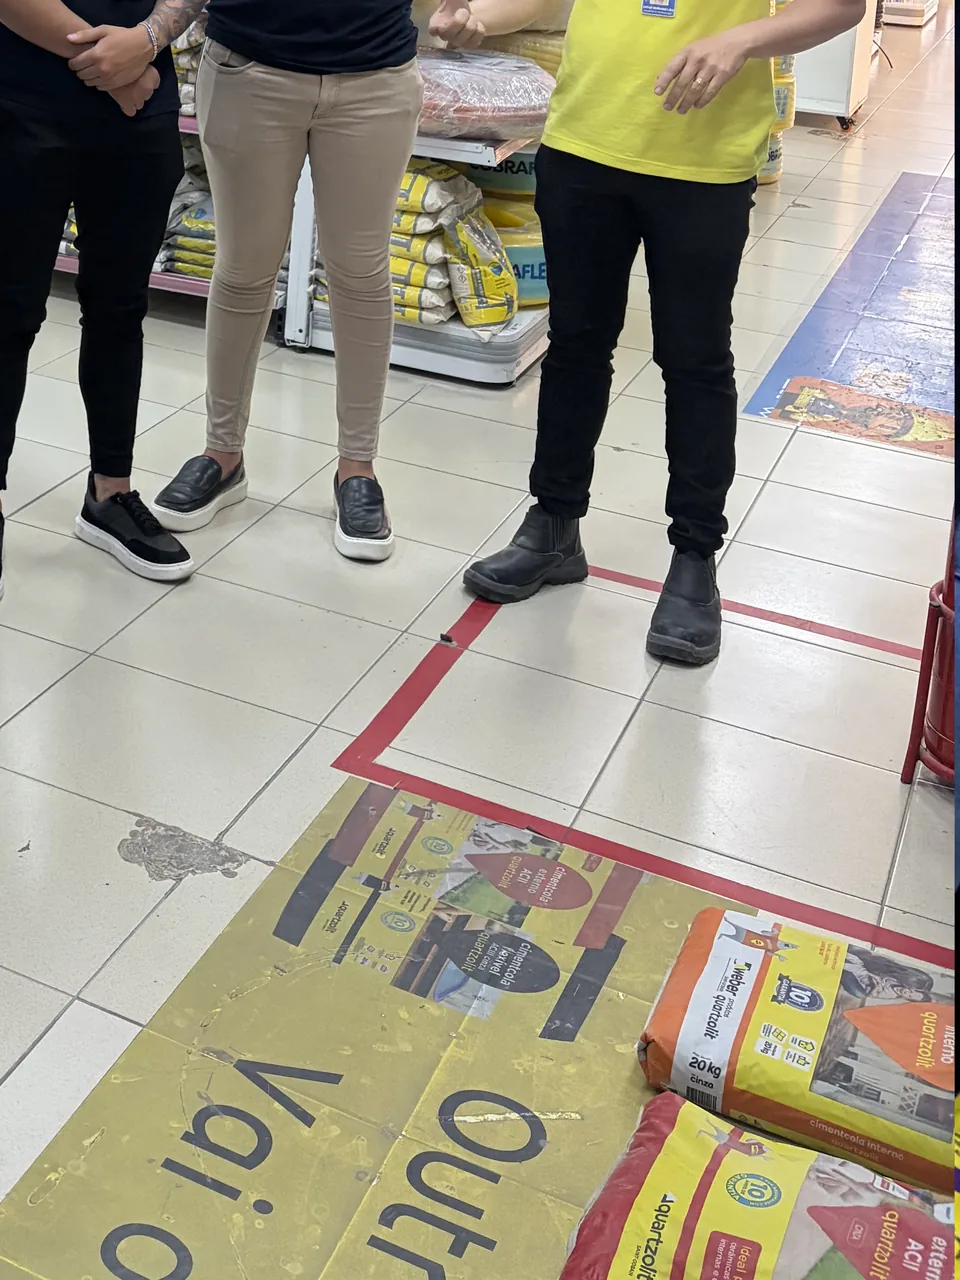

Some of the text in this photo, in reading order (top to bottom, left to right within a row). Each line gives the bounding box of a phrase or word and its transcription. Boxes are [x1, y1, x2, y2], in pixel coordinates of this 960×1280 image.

[497, 855, 523, 889] quartzolit
[528, 868, 548, 894] externo
[539, 866, 566, 902] cimentcola
[461, 932, 490, 972] quartzolit
[500, 942, 532, 986] cimentcola
[725, 967, 746, 996] weber
[789, 987, 812, 1001] 10
[704, 994, 726, 1040] quartzolit
[915, 1011, 938, 1069] quartzolit
[690, 1075, 714, 1089] cinza
[160, 1058, 344, 1215] Vai
[810, 1119, 905, 1162] cimentcola interno
[747, 1183, 768, 1199] 10
[636, 1204, 672, 1280] quartzolit
[714, 1239, 727, 1268] internas
[733, 1245, 753, 1273] Ideal
[868, 1210, 900, 1280] quartzolit
[901, 1238, 924, 1271] ACII
[723, 1242, 738, 1280] cerâmicas
